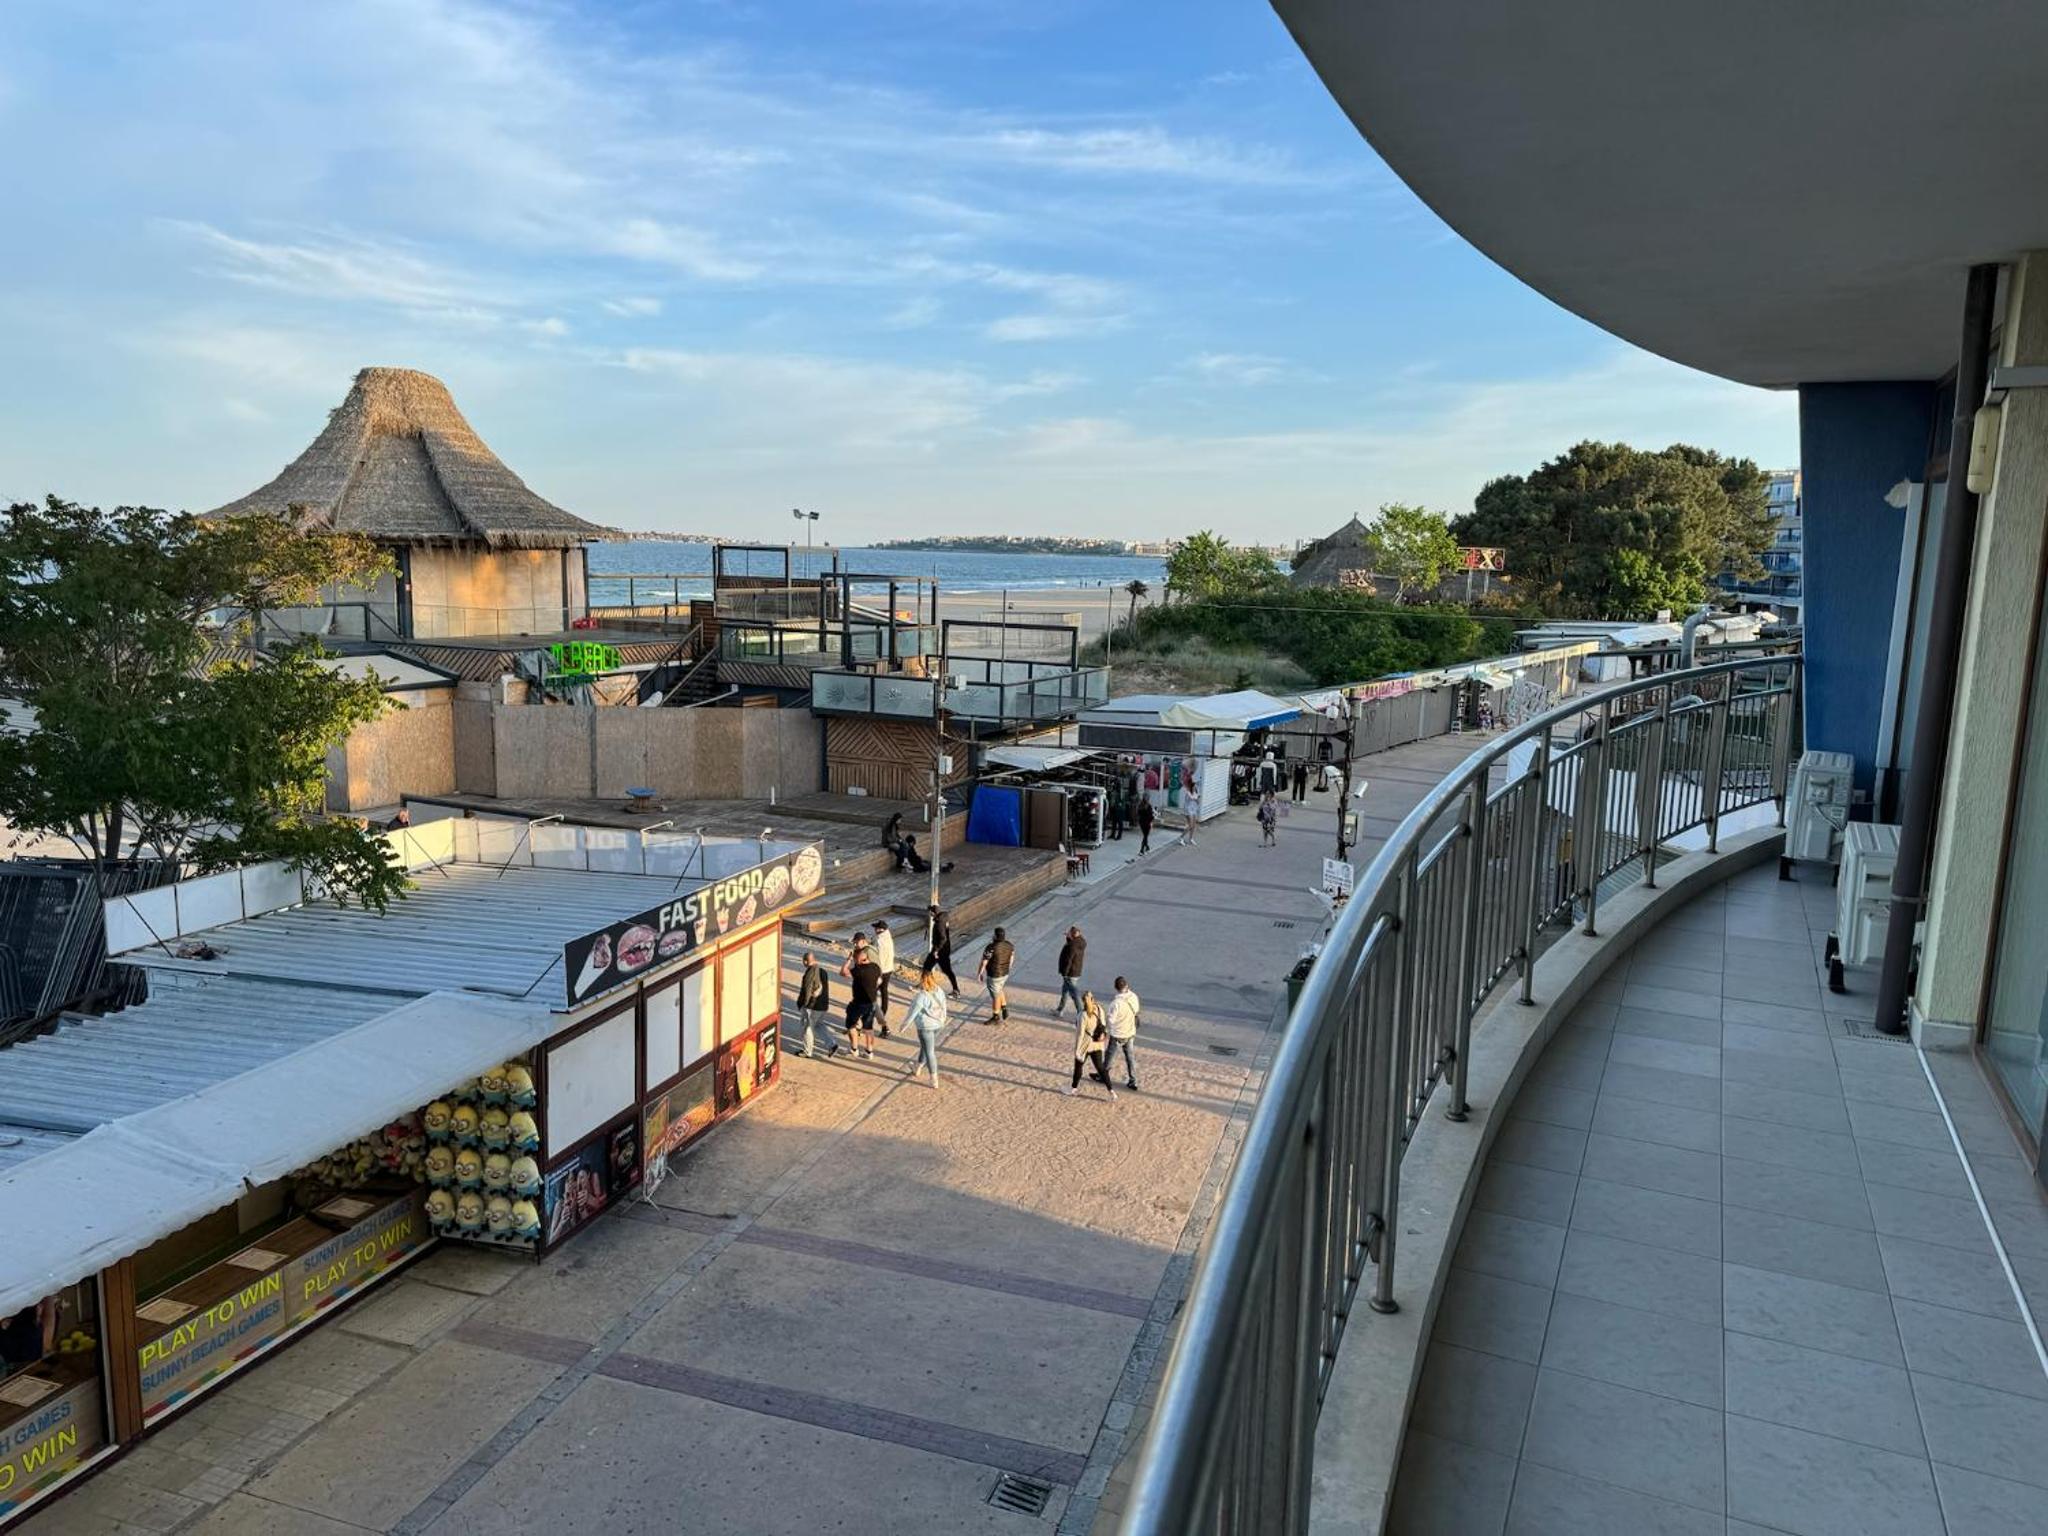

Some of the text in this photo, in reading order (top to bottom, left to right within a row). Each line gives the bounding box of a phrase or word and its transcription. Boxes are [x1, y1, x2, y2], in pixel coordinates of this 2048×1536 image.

[659, 868, 764, 934] FAST FOOD
[304, 1239, 343, 1273] SUNNY
[304, 1216, 412, 1300] PLAY TO WIN
[140, 1271, 282, 1369] PLAY TO WIN
[142, 1300, 281, 1393] SUNNY BEACH GAMES
[15, 1401, 72, 1443] GAMES
[22, 1423, 77, 1474] WIN
